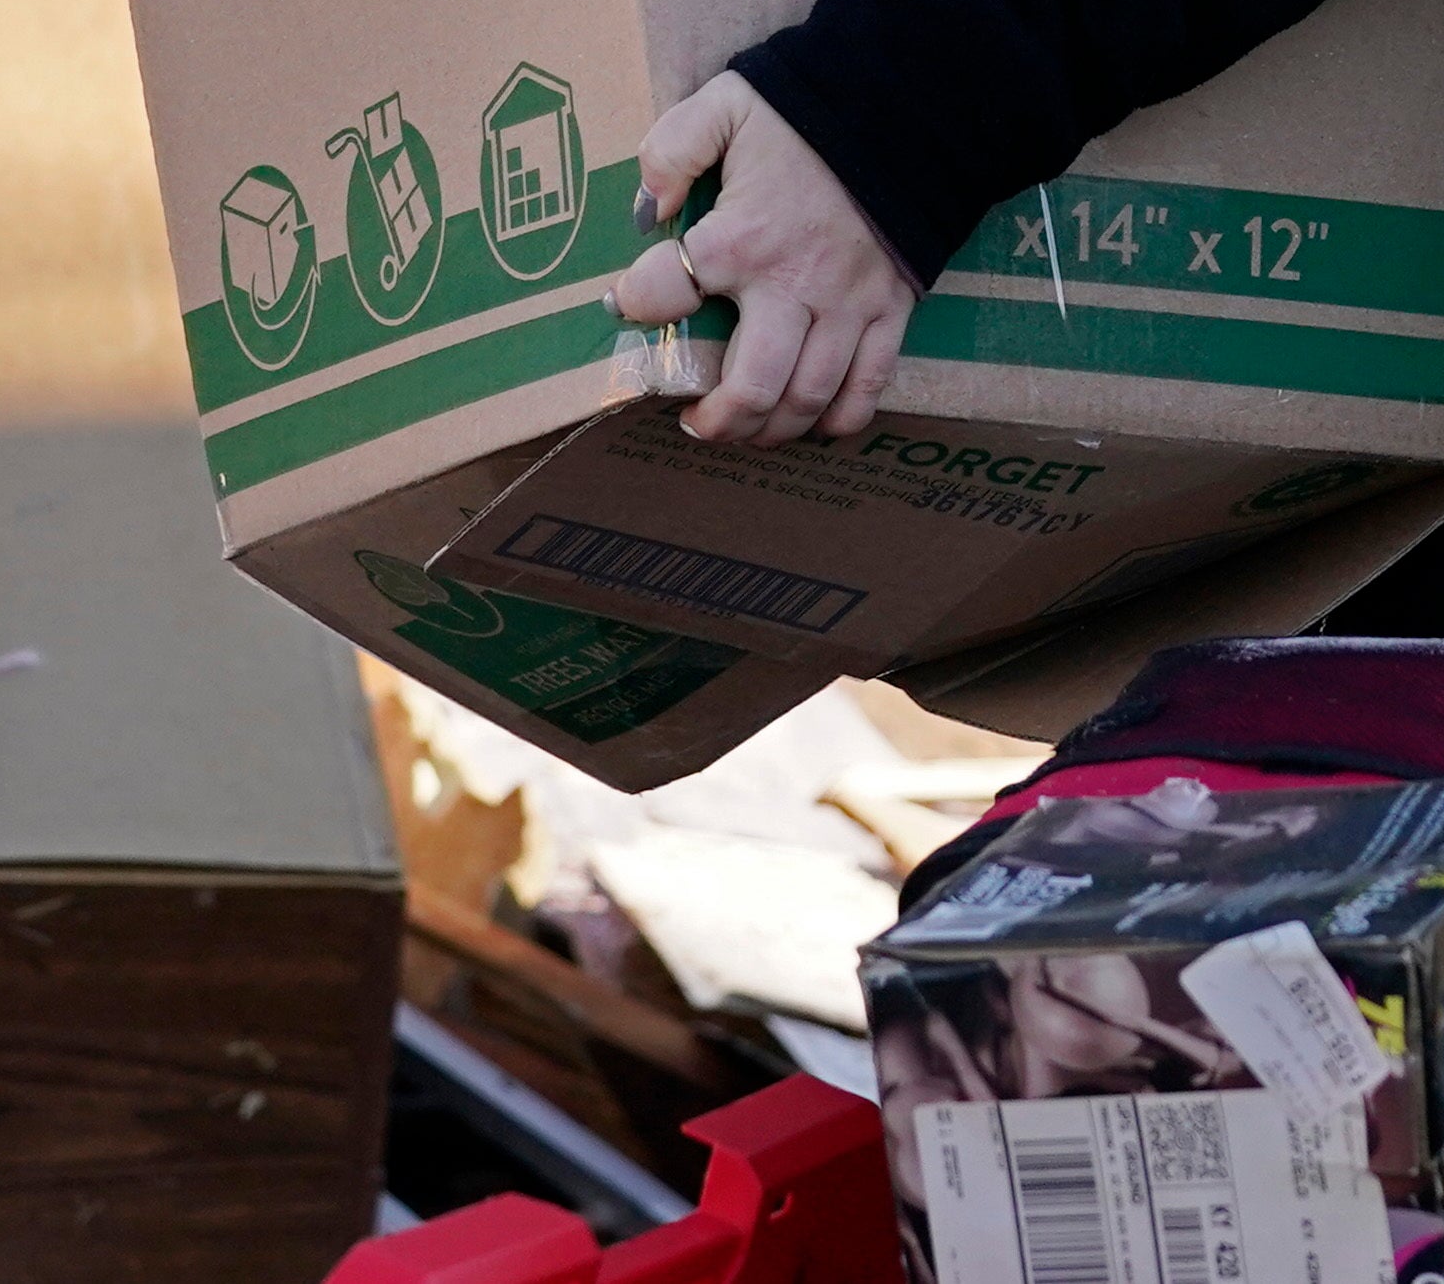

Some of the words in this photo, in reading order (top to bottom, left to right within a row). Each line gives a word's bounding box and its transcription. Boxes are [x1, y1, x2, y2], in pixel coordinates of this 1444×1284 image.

[1013, 214, 1049, 260] x
[1070, 200, 1169, 266] 14"
[1187, 230, 1224, 274] x
[1243, 216, 1330, 282] 12"
[606, 444, 657, 463] TAPE
[663, 455, 693, 471] TO
[696, 463, 747, 484] SEAL
[754, 478, 770, 490] &
[771, 483, 864, 510] SECURE
[692, 445, 799, 476] CUSHION
[800, 467, 851, 487] FOR
[837, 457, 885, 475] FOR
[860, 432, 1106, 495] FORGET
